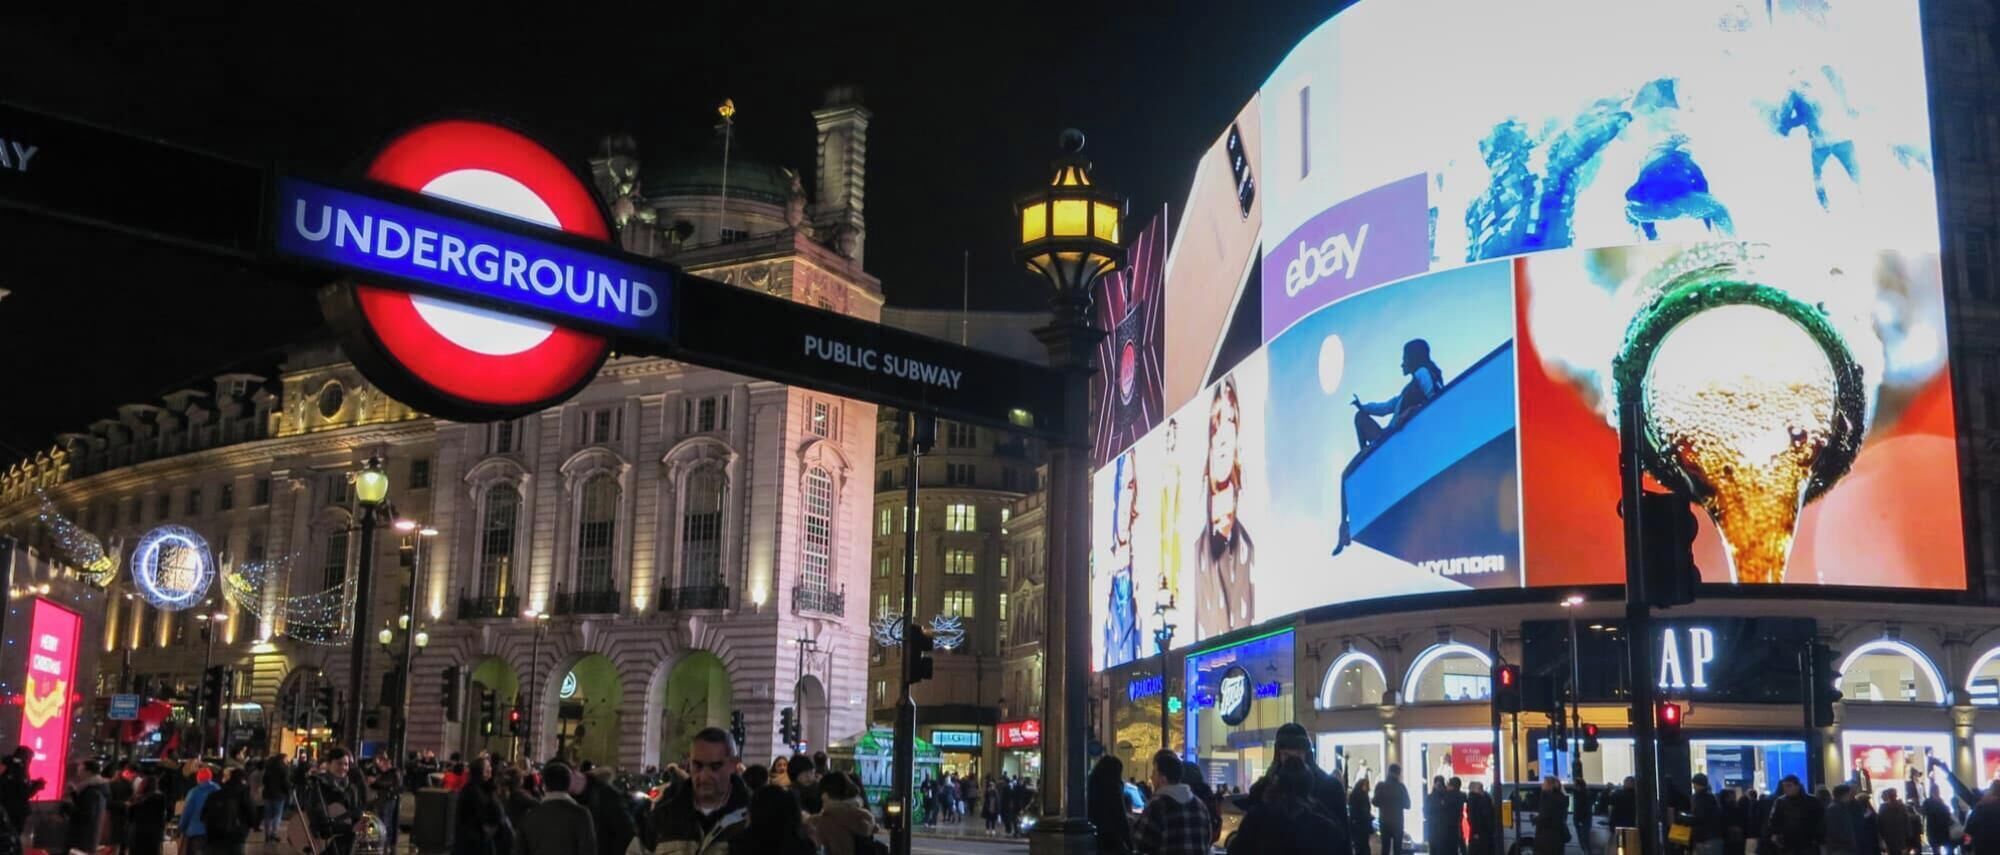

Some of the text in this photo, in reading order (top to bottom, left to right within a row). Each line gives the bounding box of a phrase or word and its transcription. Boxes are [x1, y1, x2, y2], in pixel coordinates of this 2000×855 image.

[295, 198, 659, 318] UNDERGROUND
[1285, 223, 1369, 298] ebay
[804, 335, 962, 390] PUBLIC SUBWAY
[1658, 628, 1715, 688] AP
